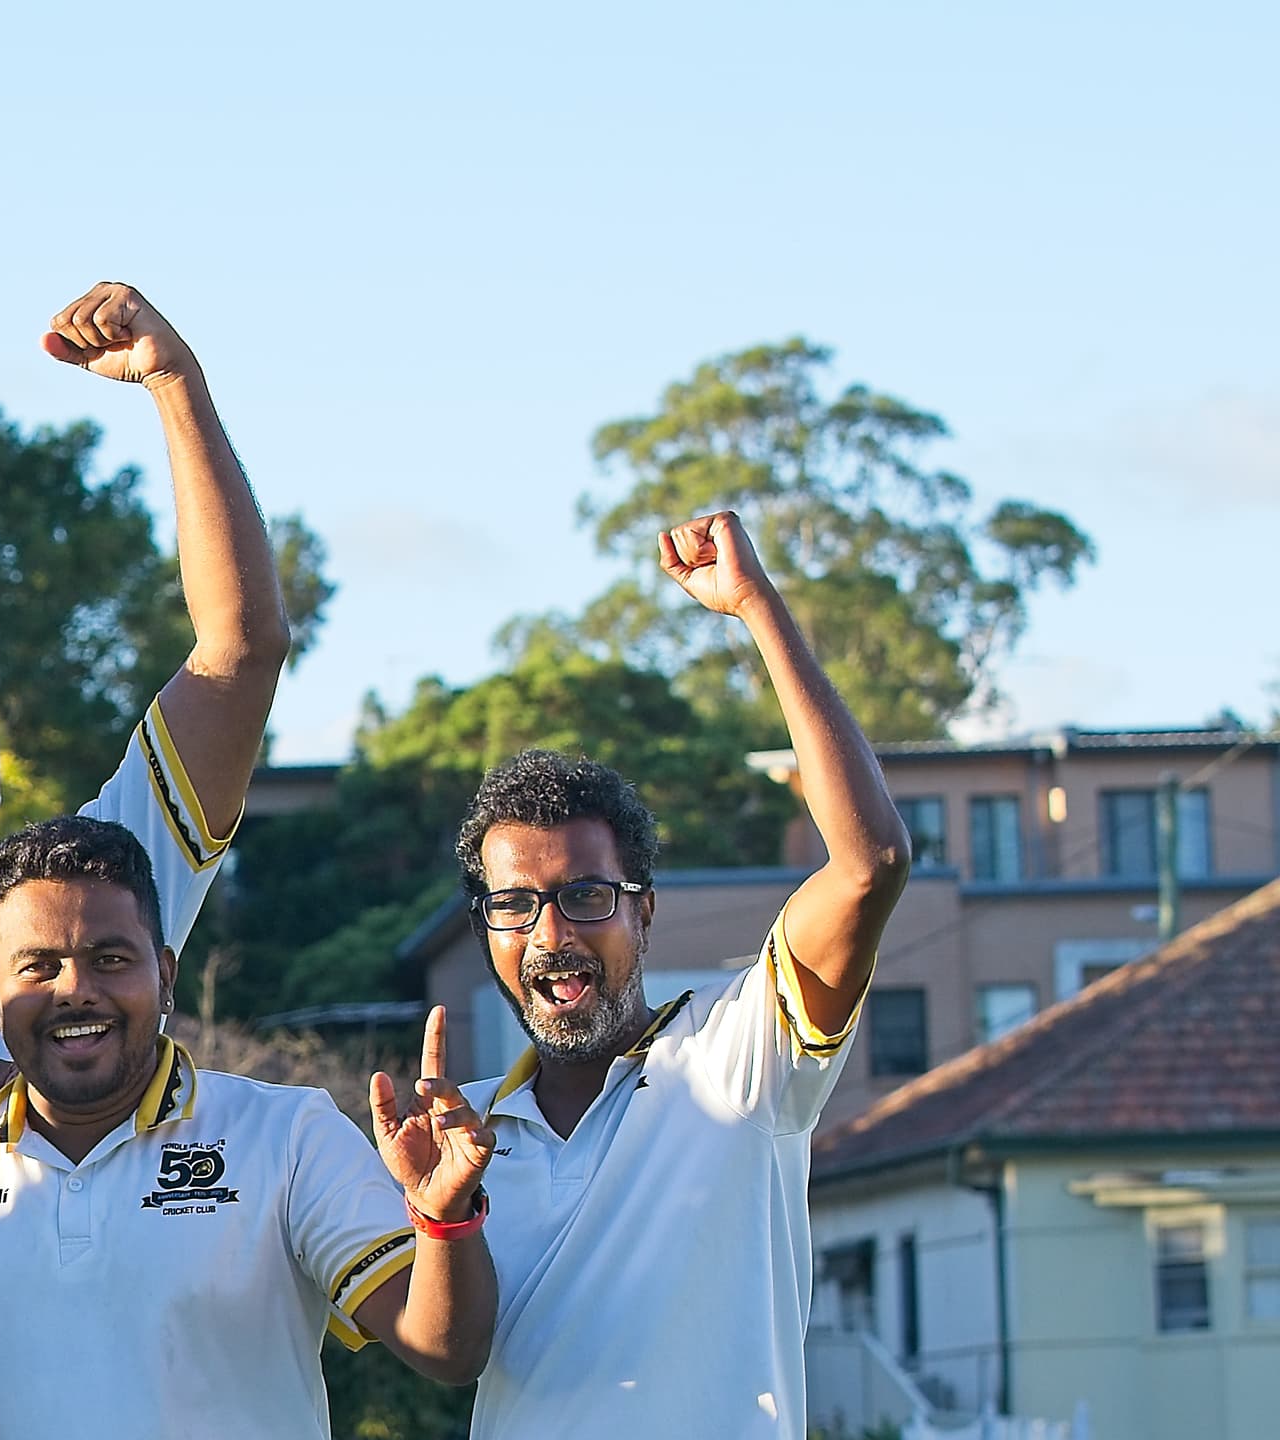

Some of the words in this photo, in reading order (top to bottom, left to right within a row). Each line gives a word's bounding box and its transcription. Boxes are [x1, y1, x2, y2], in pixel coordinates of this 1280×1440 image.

[156, 1150, 225, 1189] 50
[162, 1206, 195, 1216] CRICKET
[195, 1205, 216, 1214] CLUB
[361, 1242, 396, 1269] COLTS
